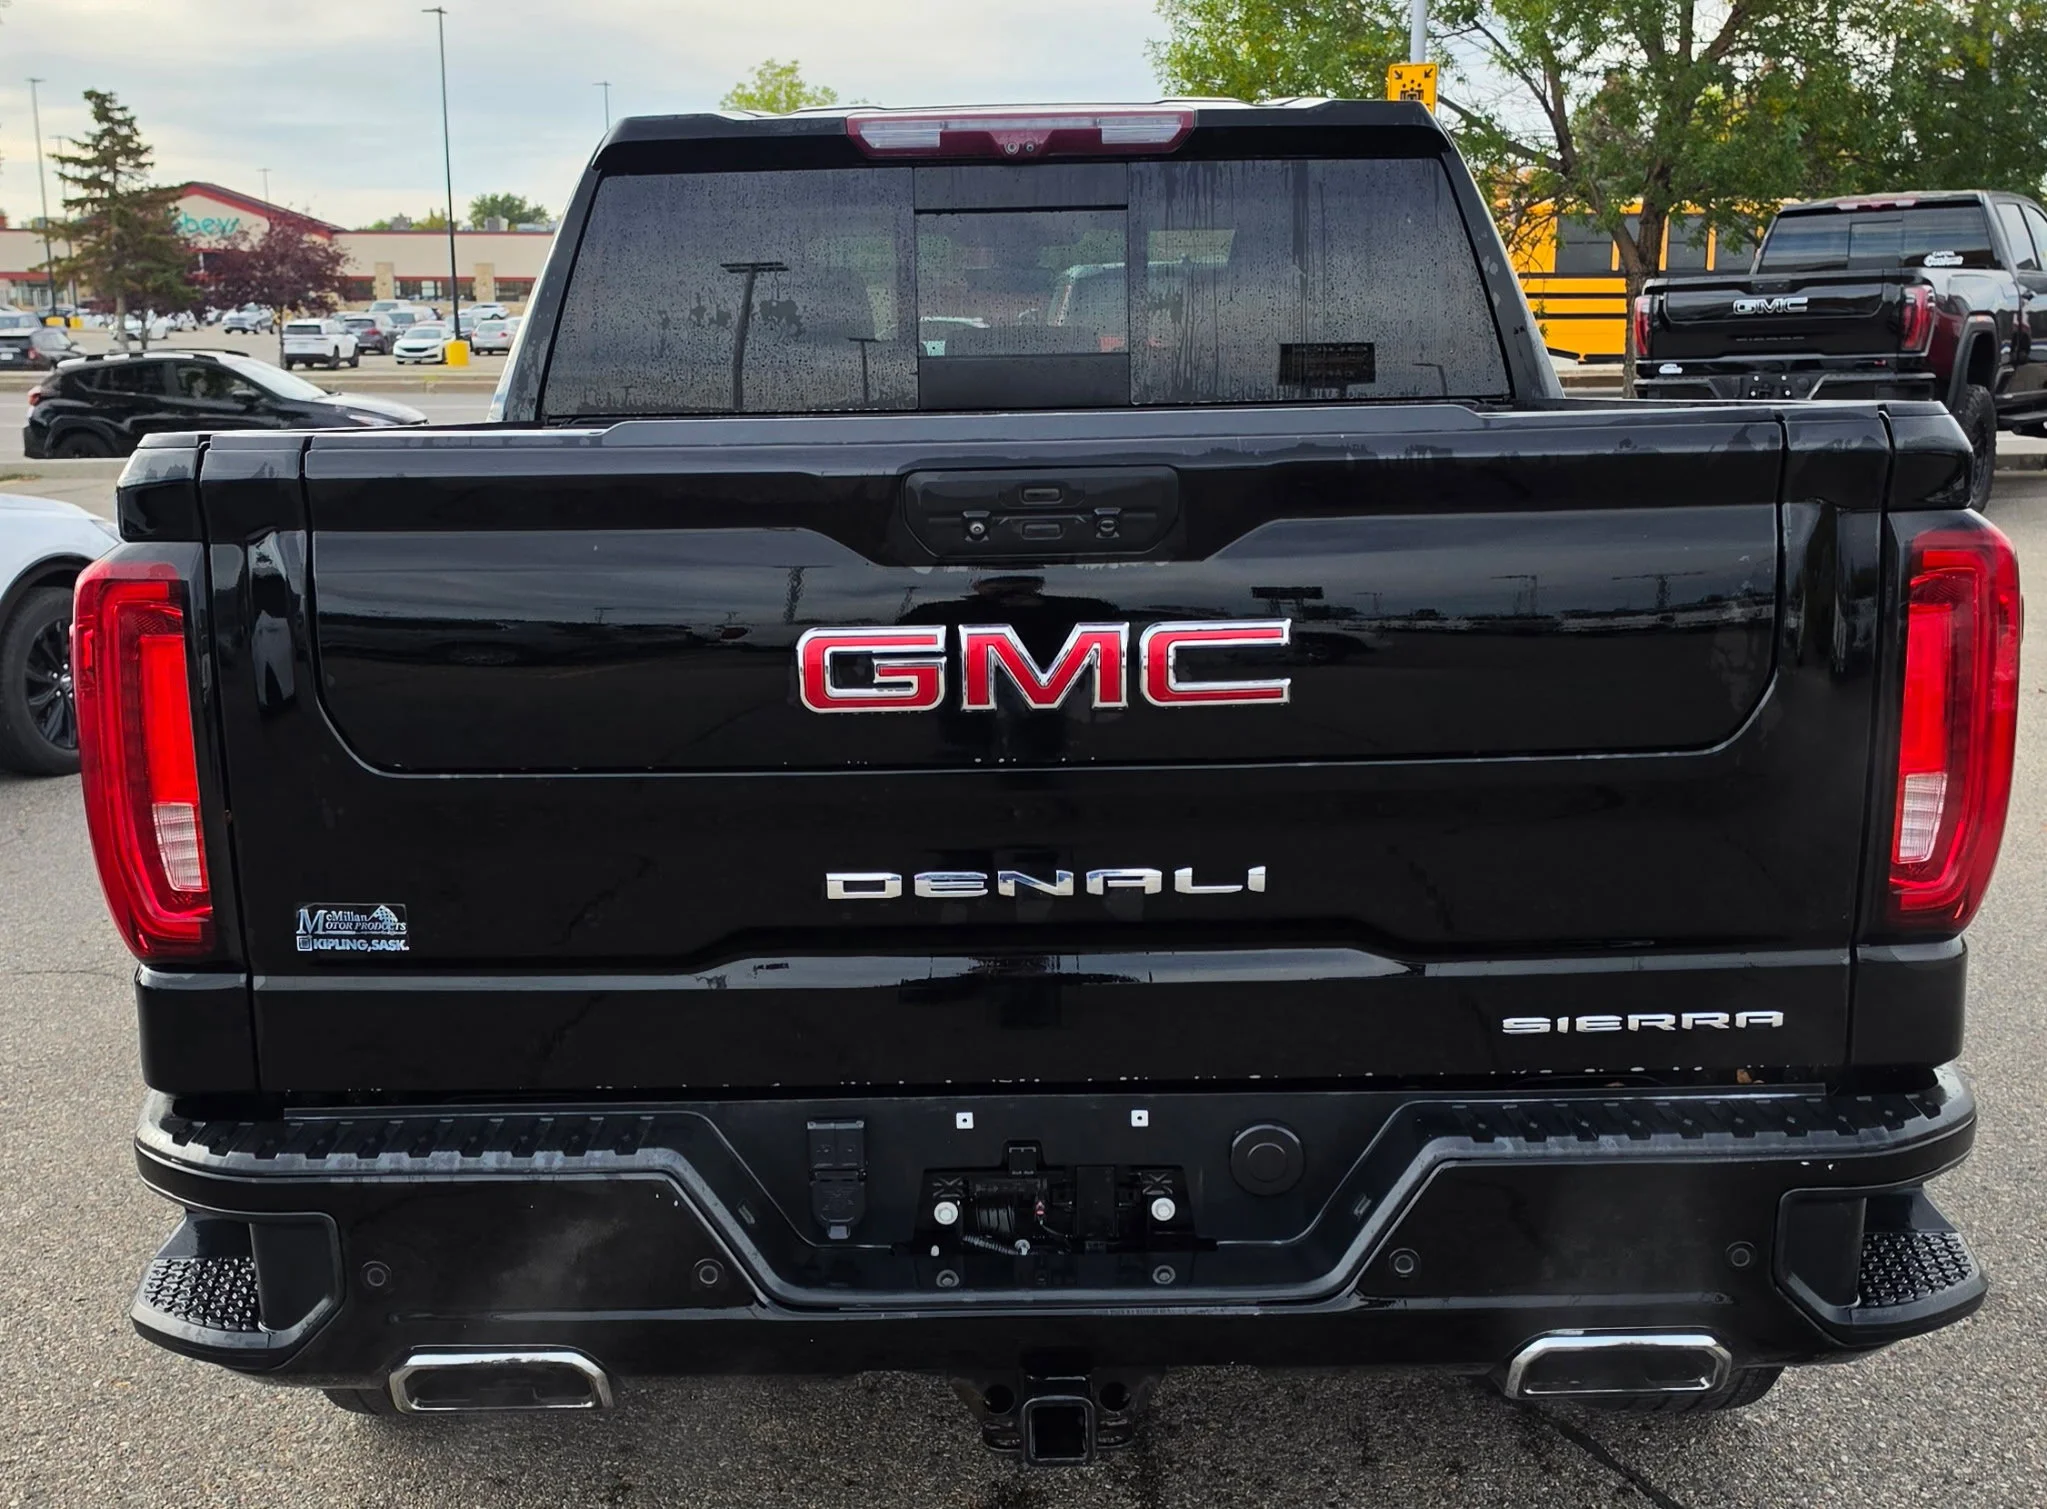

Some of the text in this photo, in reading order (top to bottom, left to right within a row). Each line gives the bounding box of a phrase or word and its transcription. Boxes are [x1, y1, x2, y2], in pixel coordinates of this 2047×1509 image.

[1733, 297, 1808, 315] GMC
[796, 619, 1292, 713] GMC
[826, 866, 1267, 899] DENALI
[296, 908, 368, 935] McMillan
[1502, 1011, 1784, 1035] SIERRA
